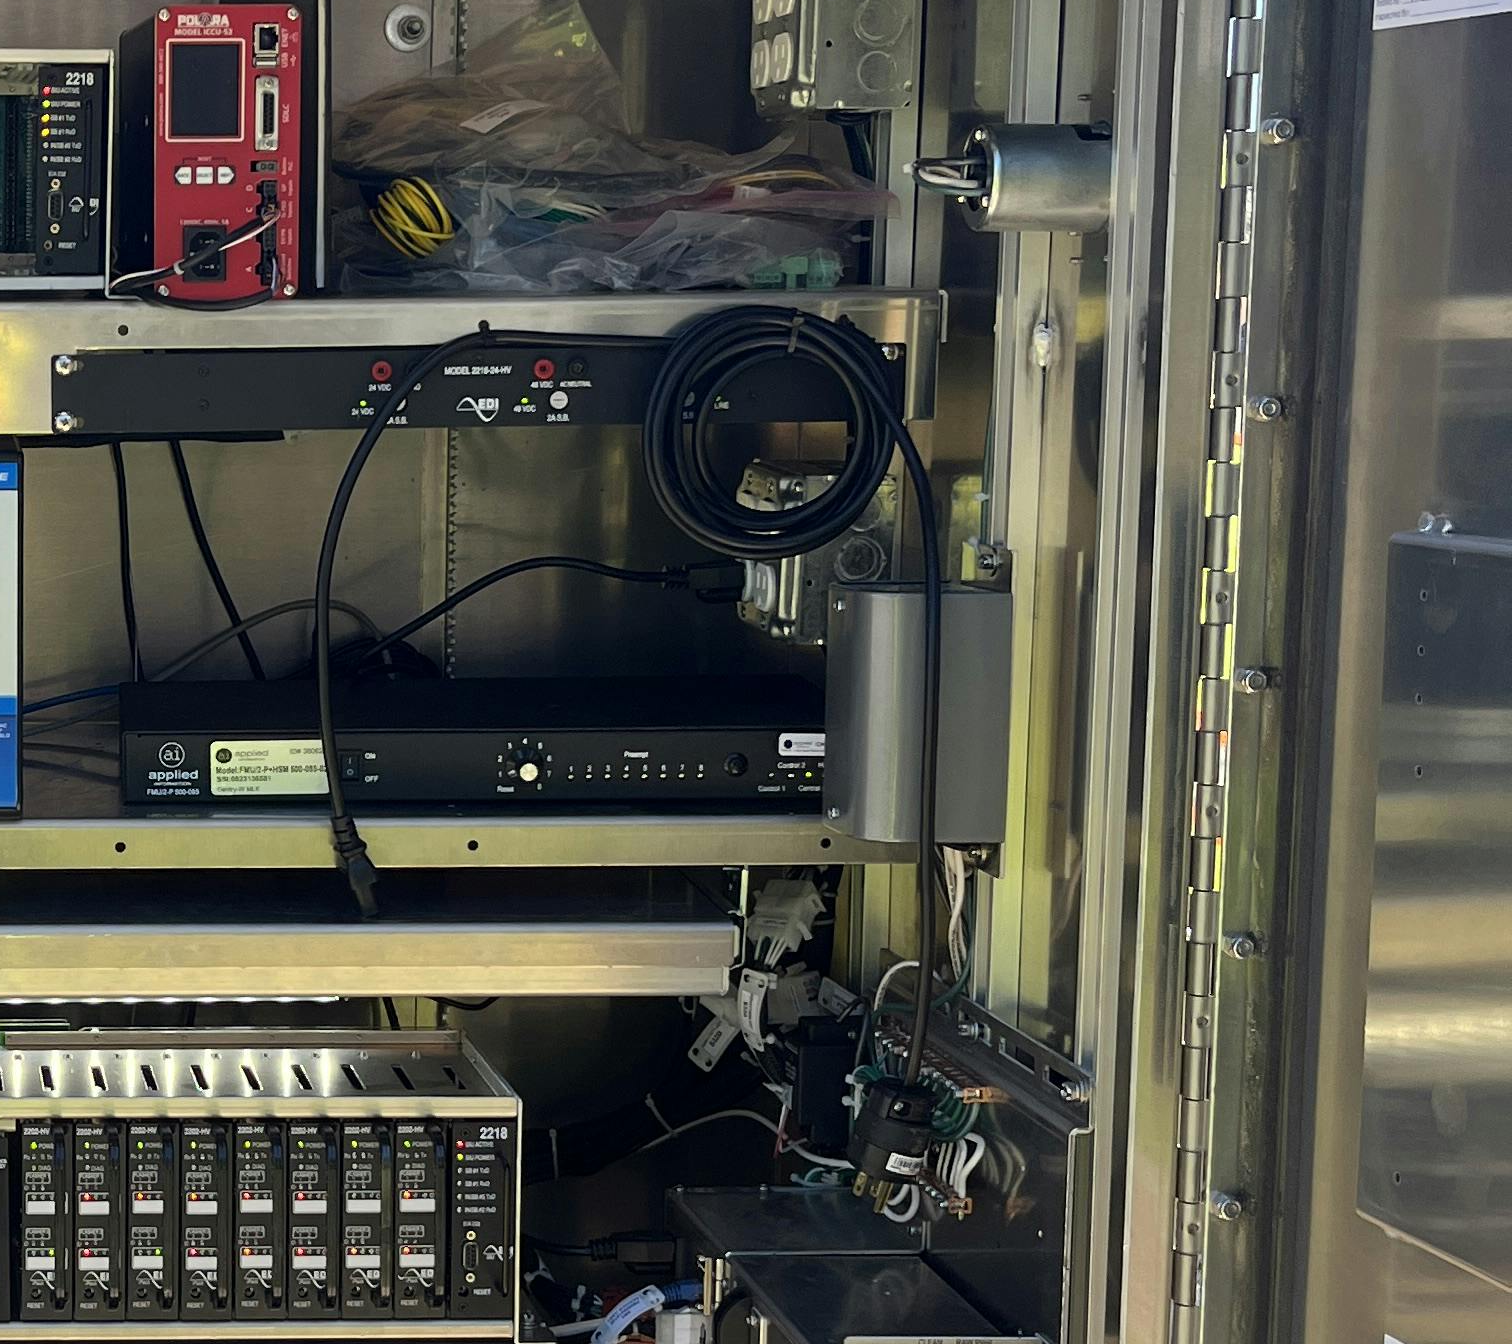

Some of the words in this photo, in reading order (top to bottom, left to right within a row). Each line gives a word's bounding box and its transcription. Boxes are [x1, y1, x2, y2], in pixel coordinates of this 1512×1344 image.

[174, 28, 203, 36] MODEL
[65, 72, 94, 86] 2218
[444, 366, 470, 375] MODEL
[478, 398, 500, 409] EDI
[163, 746, 181, 761] ai
[148, 769, 199, 781] applied
[364, 775, 379, 783] OFF
[479, 1126, 508, 1140] 2218
